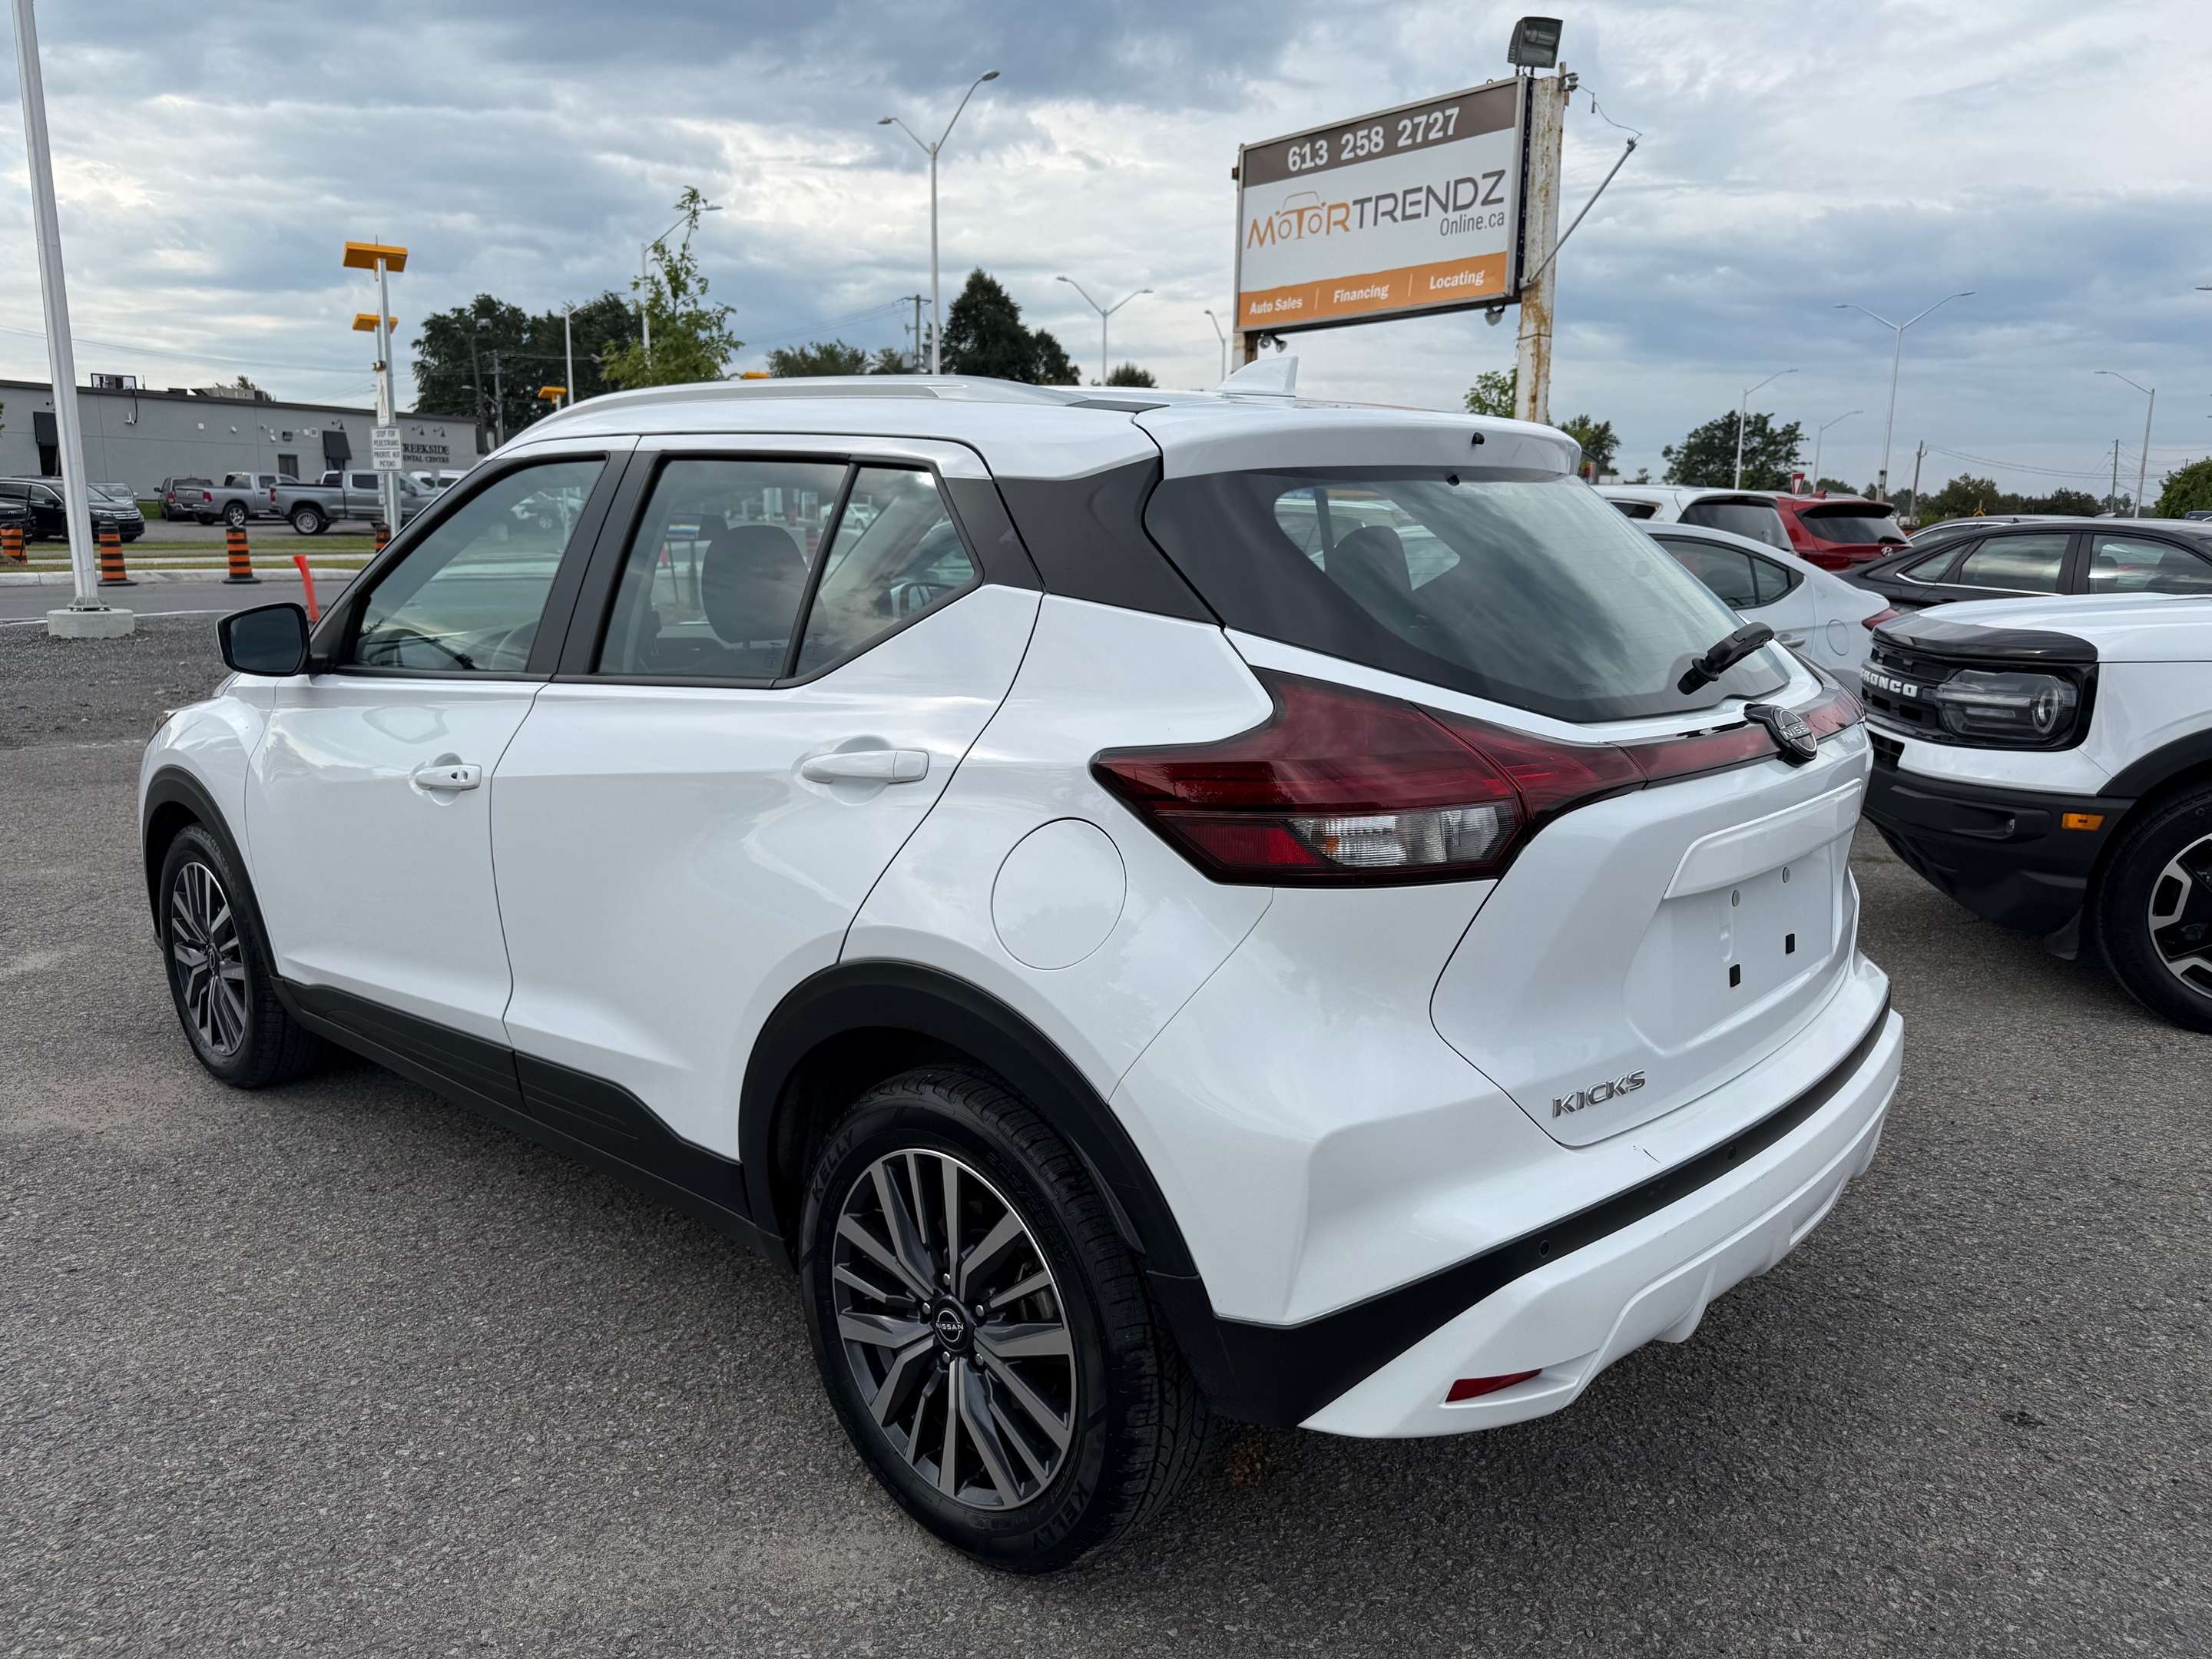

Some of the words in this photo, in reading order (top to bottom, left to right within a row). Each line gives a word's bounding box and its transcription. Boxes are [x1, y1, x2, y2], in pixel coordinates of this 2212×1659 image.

[1287, 139, 1329, 172] 613
[1340, 126, 1384, 161] 258
[1396, 106, 1460, 148] 2727
[1439, 212, 1505, 237] Online.ca
[1429, 270, 1485, 290] Locating
[1333, 283, 1389, 304] Financing
[1249, 300, 1273, 315] Auto
[1274, 296, 1303, 313] Sales
[1552, 1069, 1646, 1118] KICKS
[811, 1128, 856, 1204] KELLY
[935, 1322, 964, 1330] NISSAN
